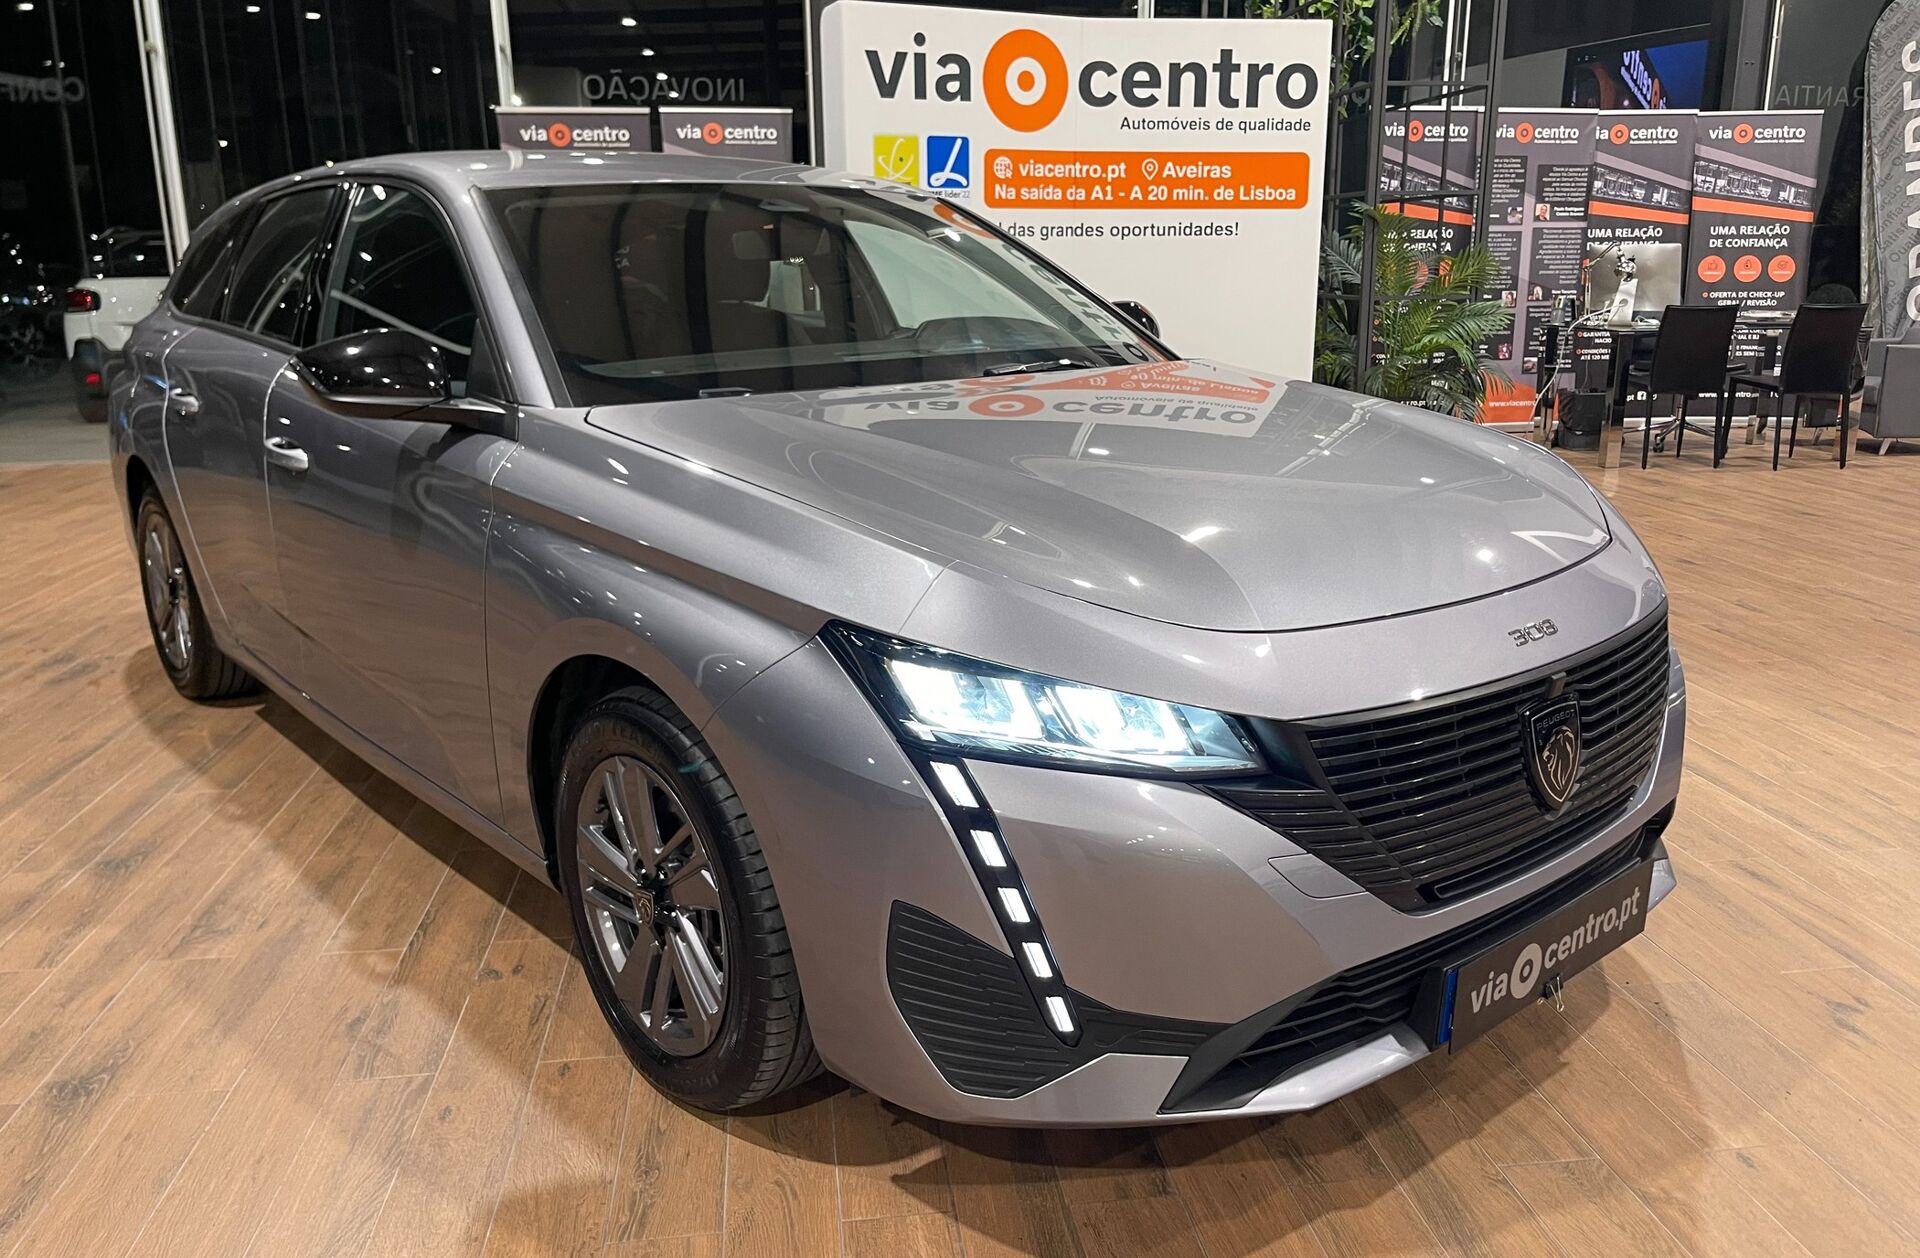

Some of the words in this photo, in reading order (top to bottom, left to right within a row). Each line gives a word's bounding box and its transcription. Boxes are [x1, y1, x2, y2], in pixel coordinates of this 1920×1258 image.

[864, 32, 972, 101] via
[1078, 48, 1319, 109] centro
[520, 125, 548, 141] via
[572, 126, 630, 141] centro
[676, 124, 702, 140] via
[724, 125, 777, 140] centro
[1120, 116, 1211, 132] Automóveis
[1216, 117, 1234, 131] de
[1239, 117, 1311, 135] qualidade
[1384, 122, 1405, 137] via
[1534, 125, 1579, 139] centro
[1596, 126, 1609, 139] ia
[1630, 126, 1679, 139] centro
[1709, 126, 1732, 139] via
[1754, 125, 1806, 138] centro
[1019, 159, 1126, 179] viacentro.pt
[1162, 161, 1232, 178] Aveiras
[994, 184, 1015, 200] Na
[1020, 185, 1062, 200] saída
[1067, 184, 1085, 201] da
[1091, 184, 1113, 200] A1
[1129, 185, 1144, 201] A
[1147, 184, 1167, 201] 20
[1173, 185, 1208, 201] min.
[1213, 185, 1234, 201] de
[1239, 185, 1296, 201] Lisboa
[1008, 222, 1035, 237] das
[1040, 222, 1104, 240] grandes
[1109, 222, 1239, 240] oportunidades!
[1587, 228, 1612, 238] UMA
[1615, 225, 1663, 240] RELAÇÃO
[1710, 225, 1737, 235] UMA
[1739, 223, 1790, 237] RELAÇÃO
[1709, 239, 1723, 248] DE
[1725, 238, 1788, 249] CONFIANÇA
[1508, 618, 1559, 648] 308
[1535, 709, 1576, 730] PEUGEOT
[1470, 971, 1508, 1014] via
[1544, 886, 1641, 969] centro.pt
